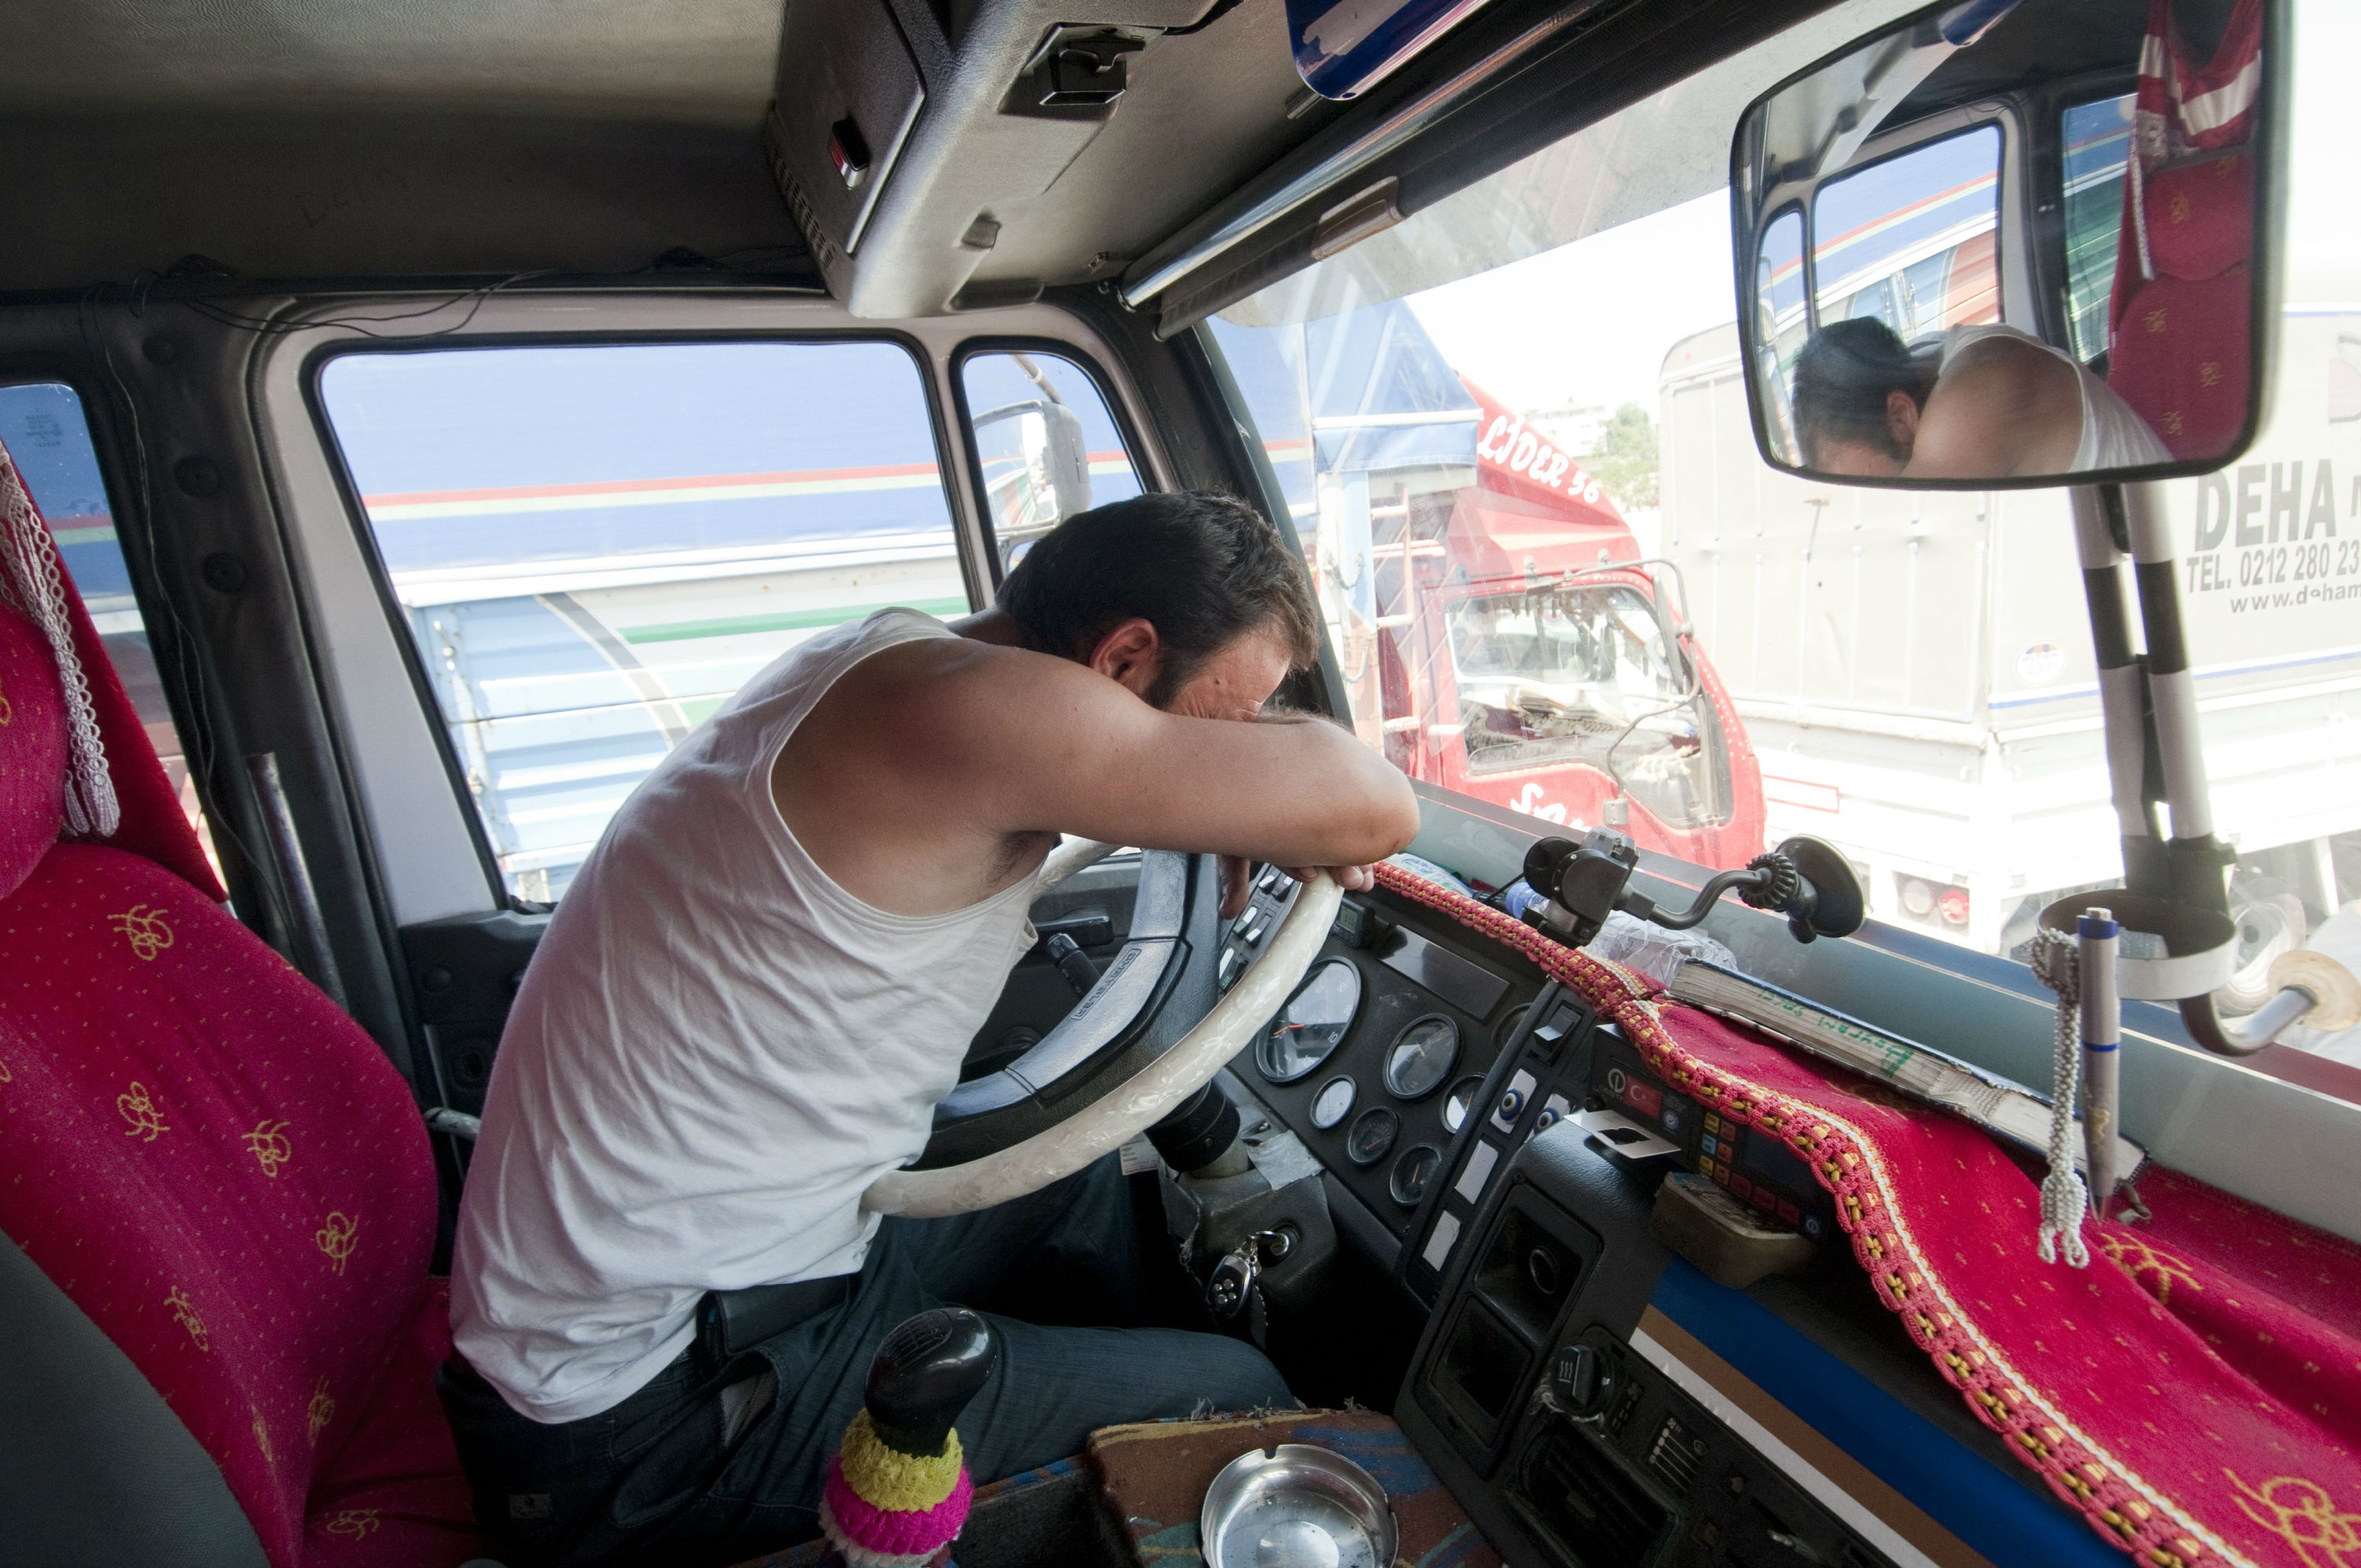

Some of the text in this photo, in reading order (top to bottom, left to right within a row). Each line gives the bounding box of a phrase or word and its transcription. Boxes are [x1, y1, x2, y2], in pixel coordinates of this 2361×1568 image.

[1568, 470, 1599, 504] 56
[2194, 458, 2337, 552] DEHA
[2186, 554, 2232, 593] TEL.
[2240, 547, 2288, 587] 0212
[2293, 542, 2330, 581] 280
